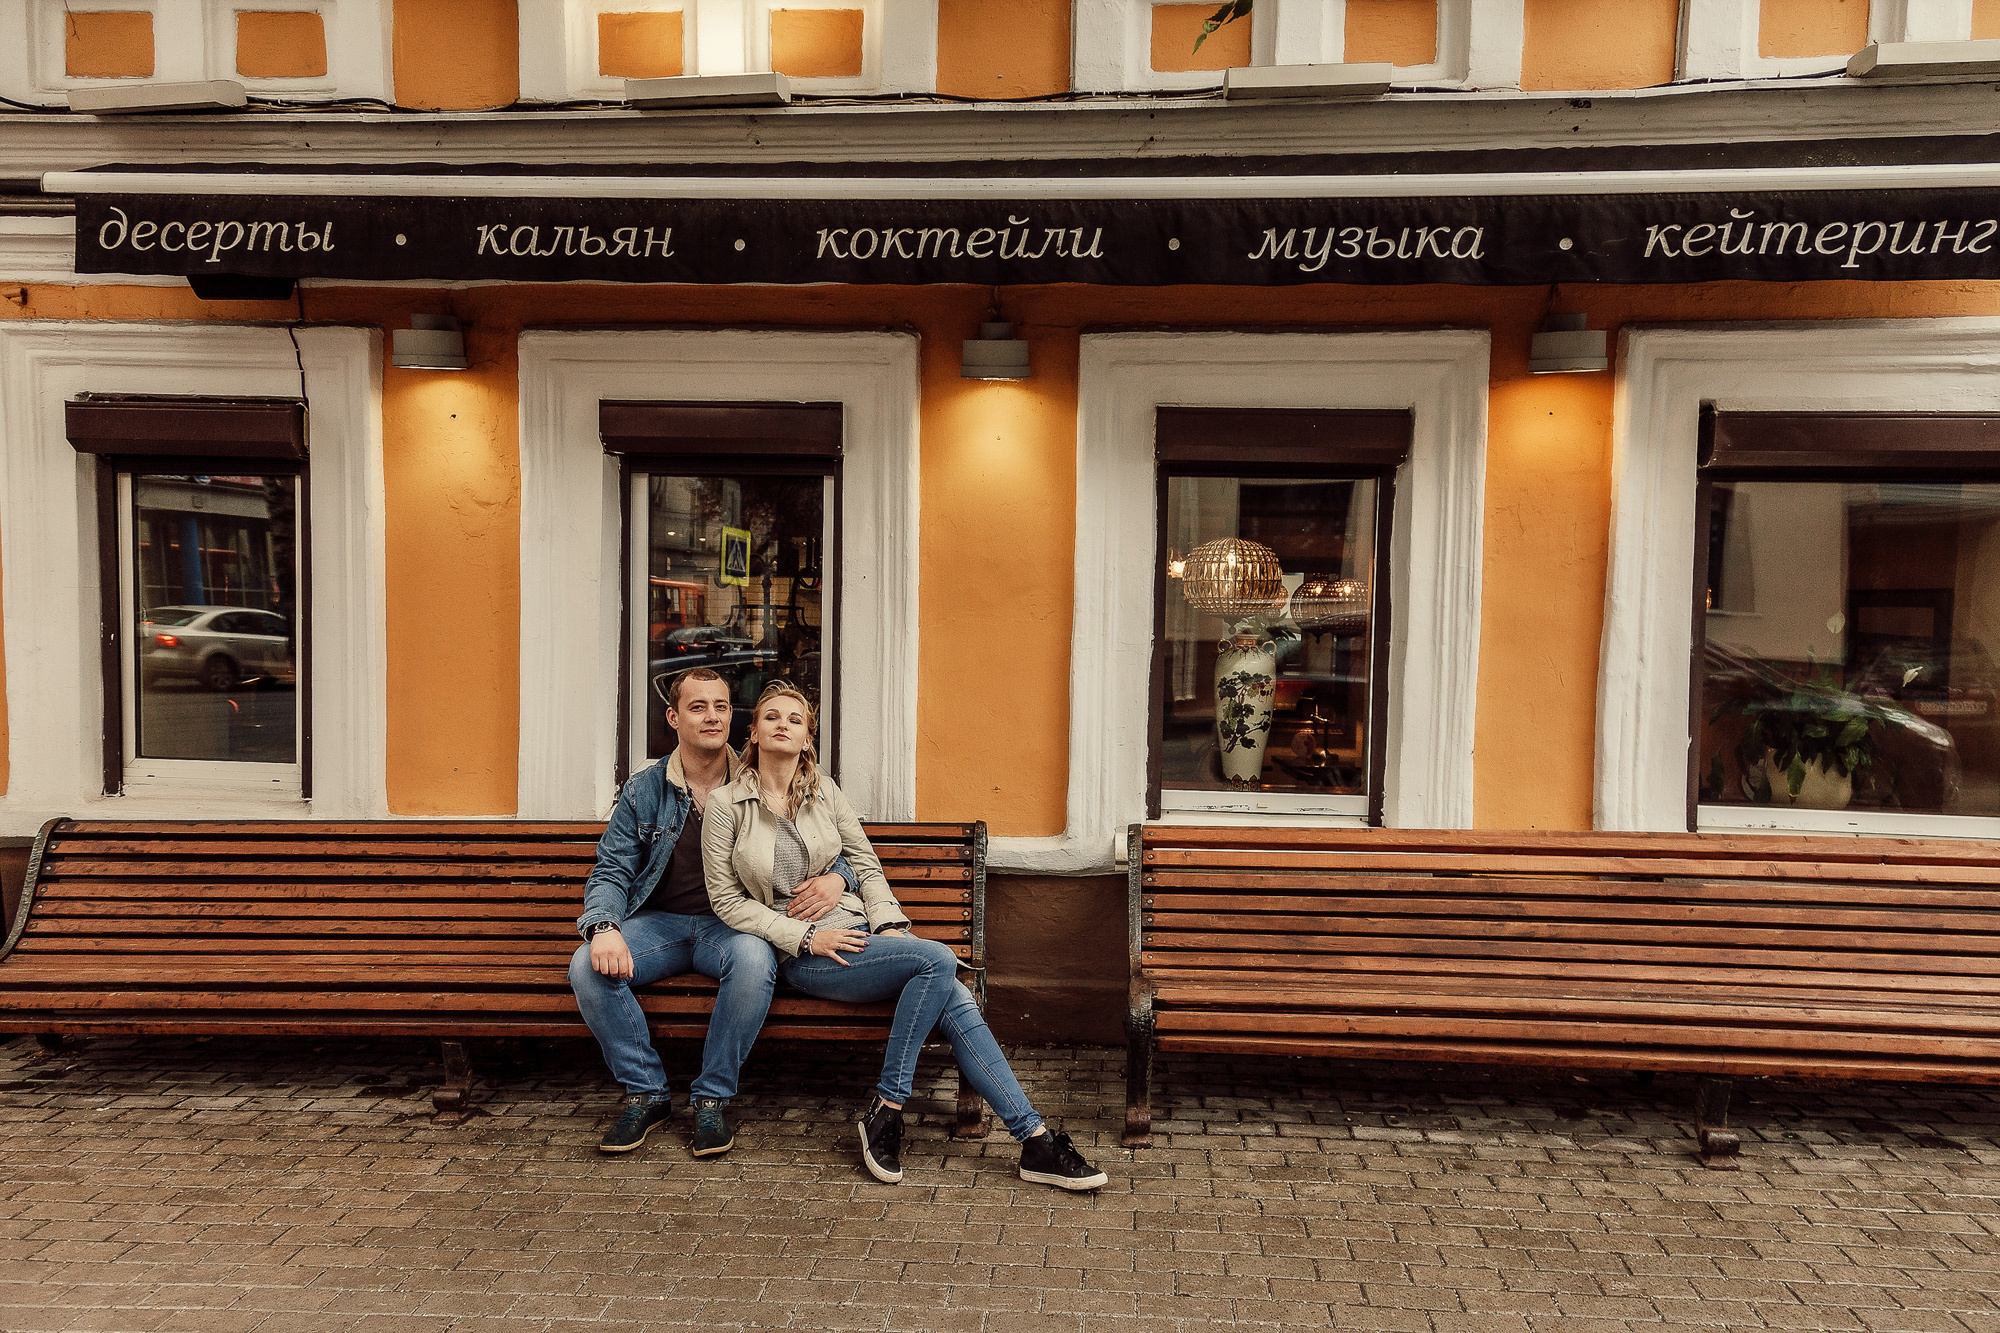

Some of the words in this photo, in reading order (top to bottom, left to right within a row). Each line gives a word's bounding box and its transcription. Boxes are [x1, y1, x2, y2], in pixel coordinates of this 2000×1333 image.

[98, 206, 335, 262] десерты
[476, 223, 675, 259] кальян
[816, 214, 1104, 260] коктейли
[1247, 224, 1485, 273] музыка
[1643, 207, 1998, 268] кейтеринг
